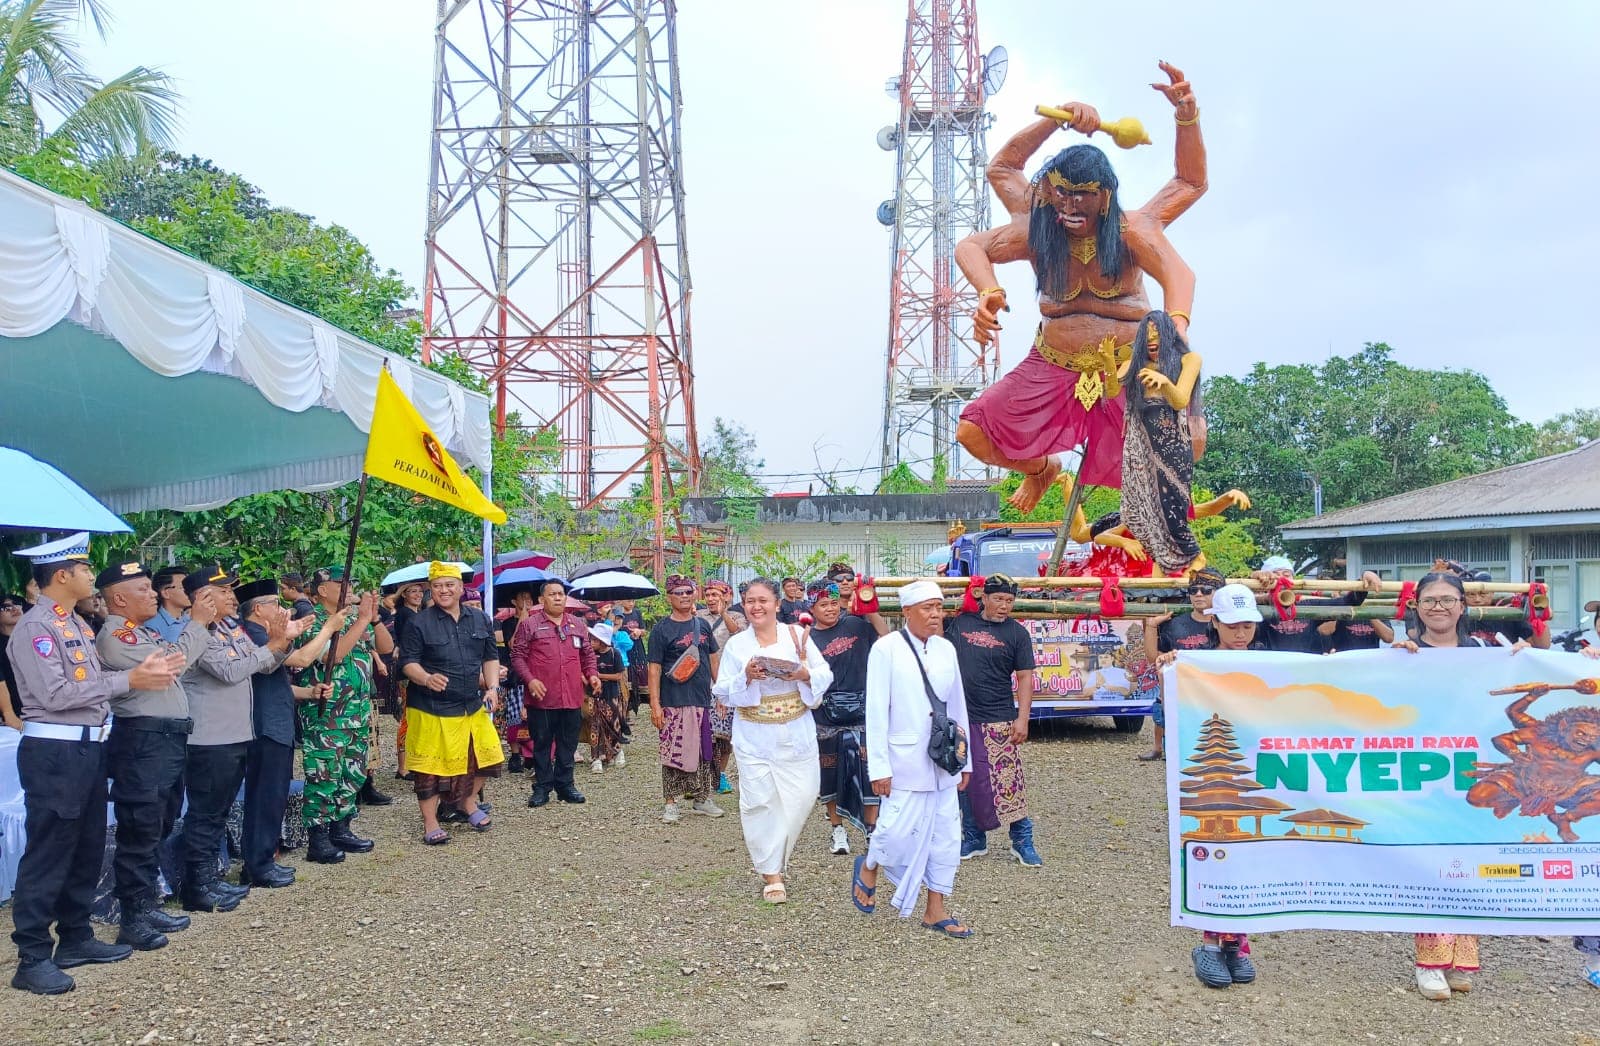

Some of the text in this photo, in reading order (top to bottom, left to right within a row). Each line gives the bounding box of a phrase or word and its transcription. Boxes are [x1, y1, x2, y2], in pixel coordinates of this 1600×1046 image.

[394, 459, 440, 486] PERADAH
[1259, 736, 1479, 750] SELAMAT HARI RAYA
[1256, 752, 1478, 792] NYEPI
[1485, 867, 1517, 875] Trakindo
[1545, 864, 1571, 876] JPC
